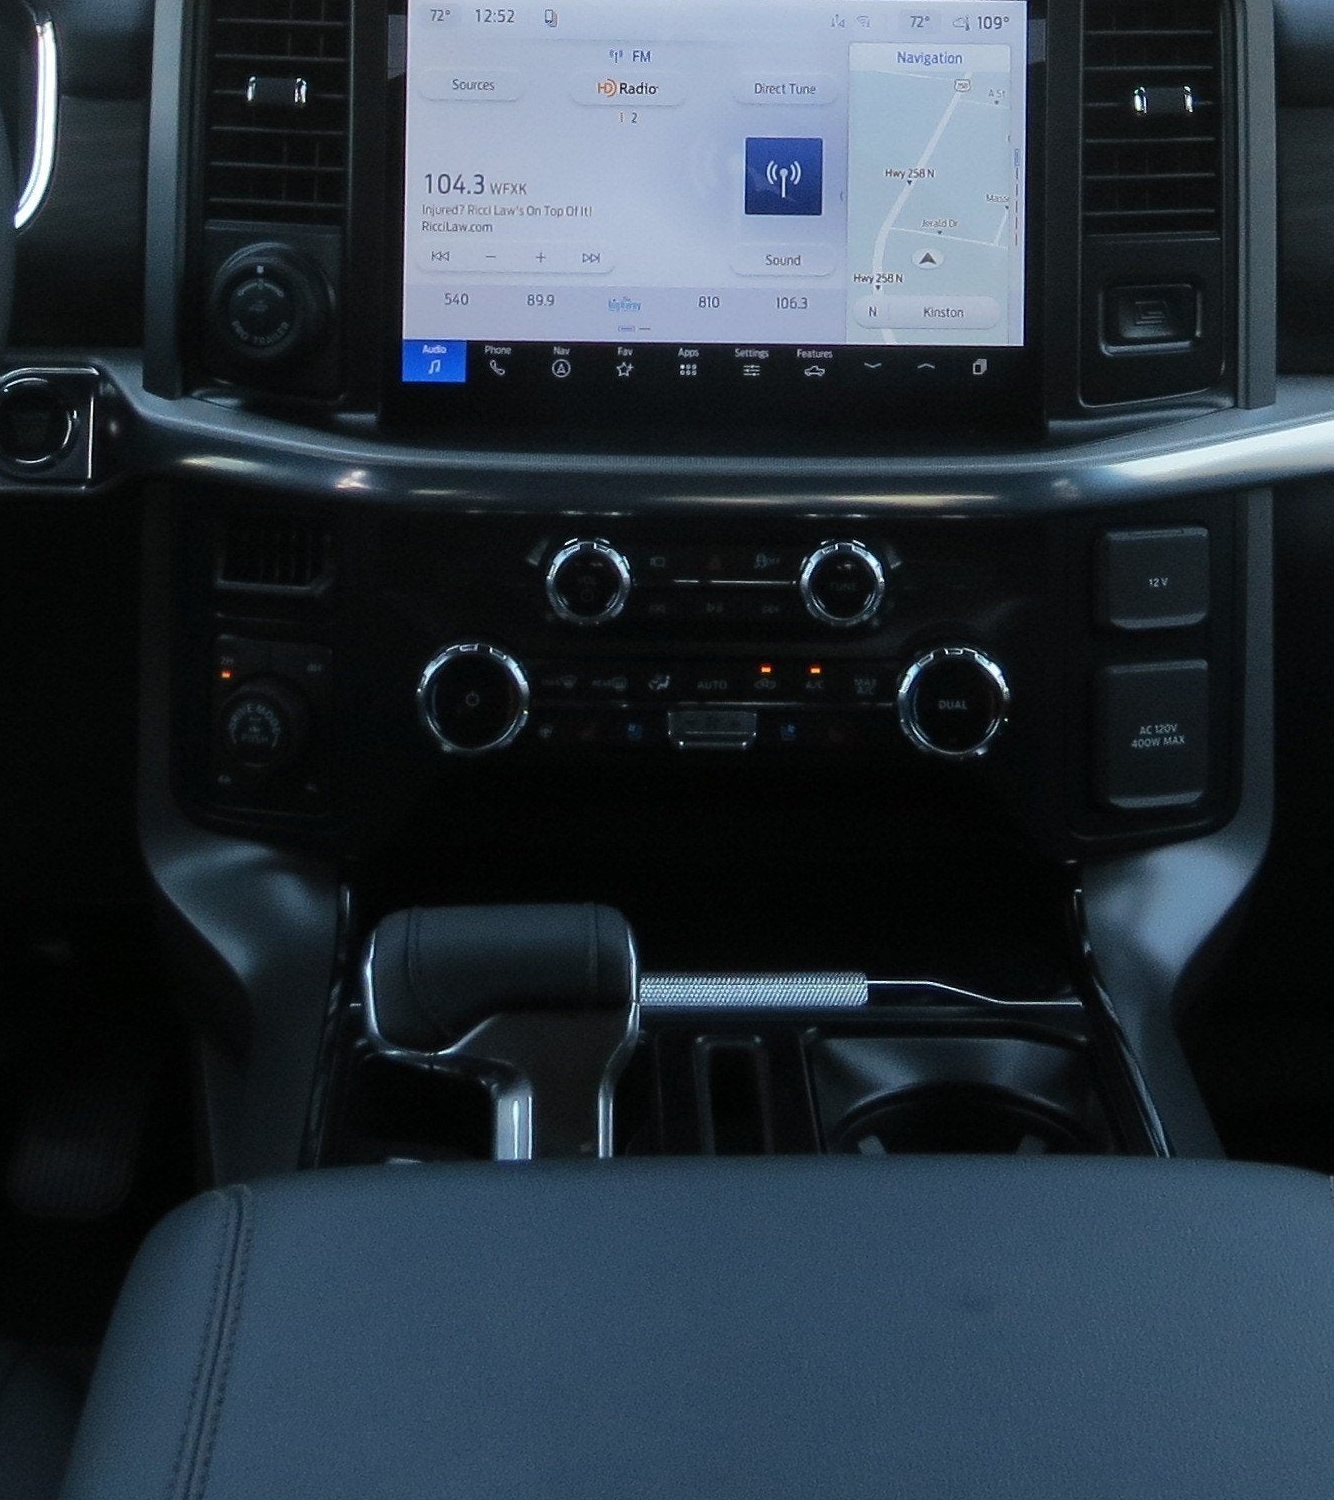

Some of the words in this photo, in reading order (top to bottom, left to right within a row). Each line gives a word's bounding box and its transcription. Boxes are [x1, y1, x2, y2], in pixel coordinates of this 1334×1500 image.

[429, 8, 452, 23] 72°
[474, 7, 516, 24] 12:52
[909, 14, 931, 28] 72°
[976, 14, 1010, 30] 109°
[632, 50, 652, 64] FM
[896, 50, 964, 67] Navigation
[451, 78, 496, 93] Sources
[619, 82, 658, 96] Radio
[754, 81, 787, 96] Direct
[788, 83, 817, 96] Tune
[631, 111, 638, 124] 2
[885, 168, 906, 181] Hwy
[907, 168, 926, 180] 258
[926, 168, 936, 180] N
[424, 173, 485, 195] 104.3
[489, 182, 528, 196] WFXK
[422, 203, 464, 218] Injured?
[467, 204, 492, 217] Ricci
[493, 204, 525, 217] Law's
[526, 205, 542, 218] On
[544, 205, 564, 219] Top
[565, 205, 578, 218] Of
[421, 220, 494, 233] RicciLaw.com
[765, 254, 803, 267] Sound
[853, 273, 874, 285] Hwy
[875, 273, 895, 284] 258
[895, 273, 905, 284] N
[444, 292, 469, 307] 540
[526, 293, 555, 308] 89.9
[697, 295, 720, 309] 810
[775, 296, 808, 311] 106.3
[868, 305, 878, 317] N
[923, 305, 965, 318] Kinston
[422, 344, 447, 356] Audio
[483, 345, 512, 357] Phone
[552, 346, 570, 357] Nav
[616, 347, 633, 358] Fav
[677, 347, 699, 361] Apps
[734, 347, 770, 361] Settings
[796, 348, 834, 361] Features
[696, 679, 728, 691] AUTO
[937, 700, 967, 712] DUAL
[1139, 723, 1154, 735] AC
[1130, 736, 1161, 749] 400W
[1163, 733, 1186, 747] MAX
